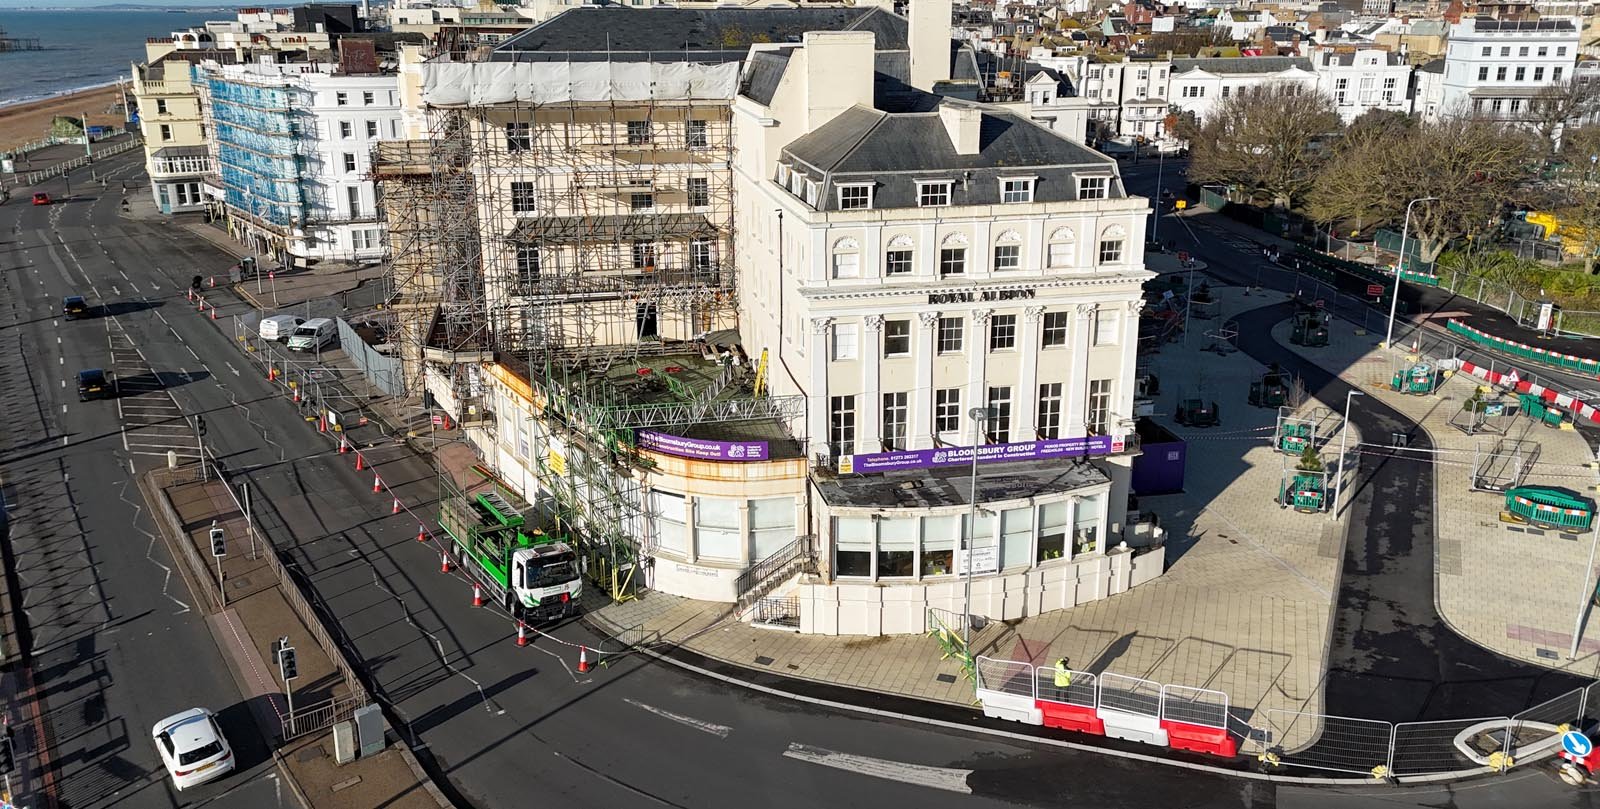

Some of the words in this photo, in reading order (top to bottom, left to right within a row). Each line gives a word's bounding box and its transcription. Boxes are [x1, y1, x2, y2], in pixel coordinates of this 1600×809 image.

[928, 293, 975, 305] ROYAL
[979, 289, 1036, 302] ALBION
[947, 446, 1005, 458] BLOOMSBURY
[1007, 443, 1036, 453] GROUP
